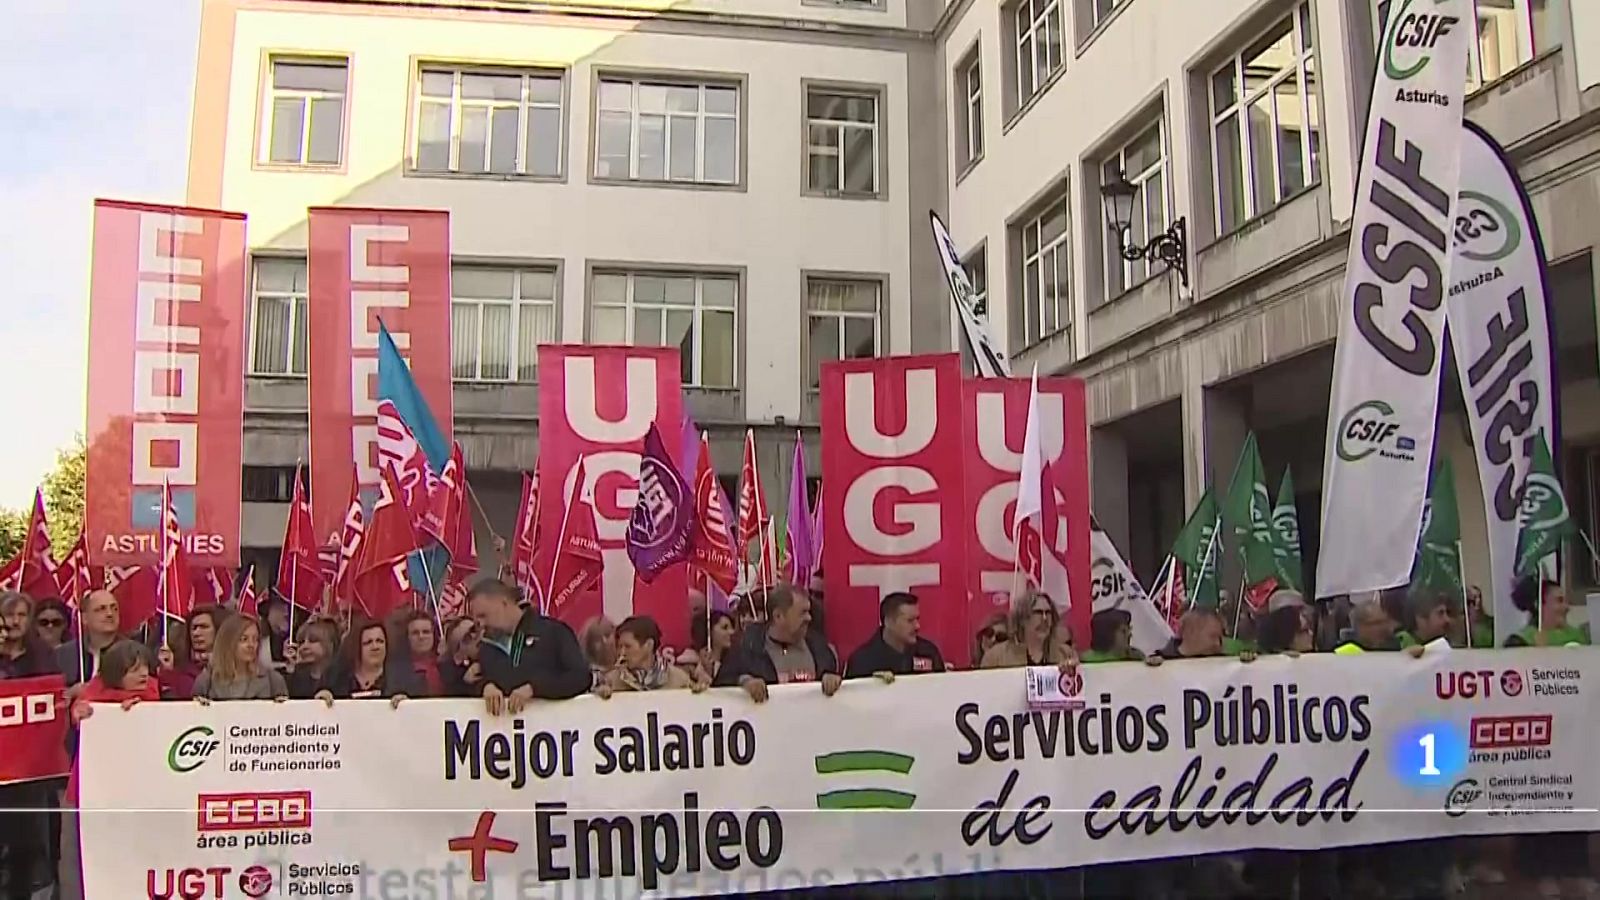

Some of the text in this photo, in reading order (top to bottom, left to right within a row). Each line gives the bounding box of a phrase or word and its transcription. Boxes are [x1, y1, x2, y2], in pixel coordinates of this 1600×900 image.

[1395, 13, 1459, 48] CSIF
[1354, 117, 1450, 376] CSIF
[132, 212, 204, 486] CCOO
[1346, 418, 1400, 443] CSIF
[843, 368, 942, 620] UGT
[103, 534, 225, 554] ASTUIES
[1436, 670, 1495, 700] UGT
[1532, 669, 1580, 681] Servicios
[1534, 683, 1579, 696] Públicos
[230, 724, 339, 738] Central Sindical
[955, 684, 1372, 765] Servicios Públicos
[1475, 720, 1548, 744] CCOO
[179, 740, 220, 757] CSIF
[230, 742, 341, 756] Independiente y
[444, 708, 756, 789] Mejor salario
[1502, 748, 1551, 765] pública
[229, 758, 341, 772] de Funcionarios
[1489, 775, 1573, 787] Central Sindical
[961, 748, 1370, 847] de calidad
[1488, 790, 1574, 801] Independiente y
[205, 798, 306, 824] CCOO
[197, 831, 312, 850] área pública
[535, 792, 783, 890] Empleo
[289, 863, 360, 878] Servicios
[147, 867, 232, 900] UGT
[289, 881, 354, 896] Públicos
